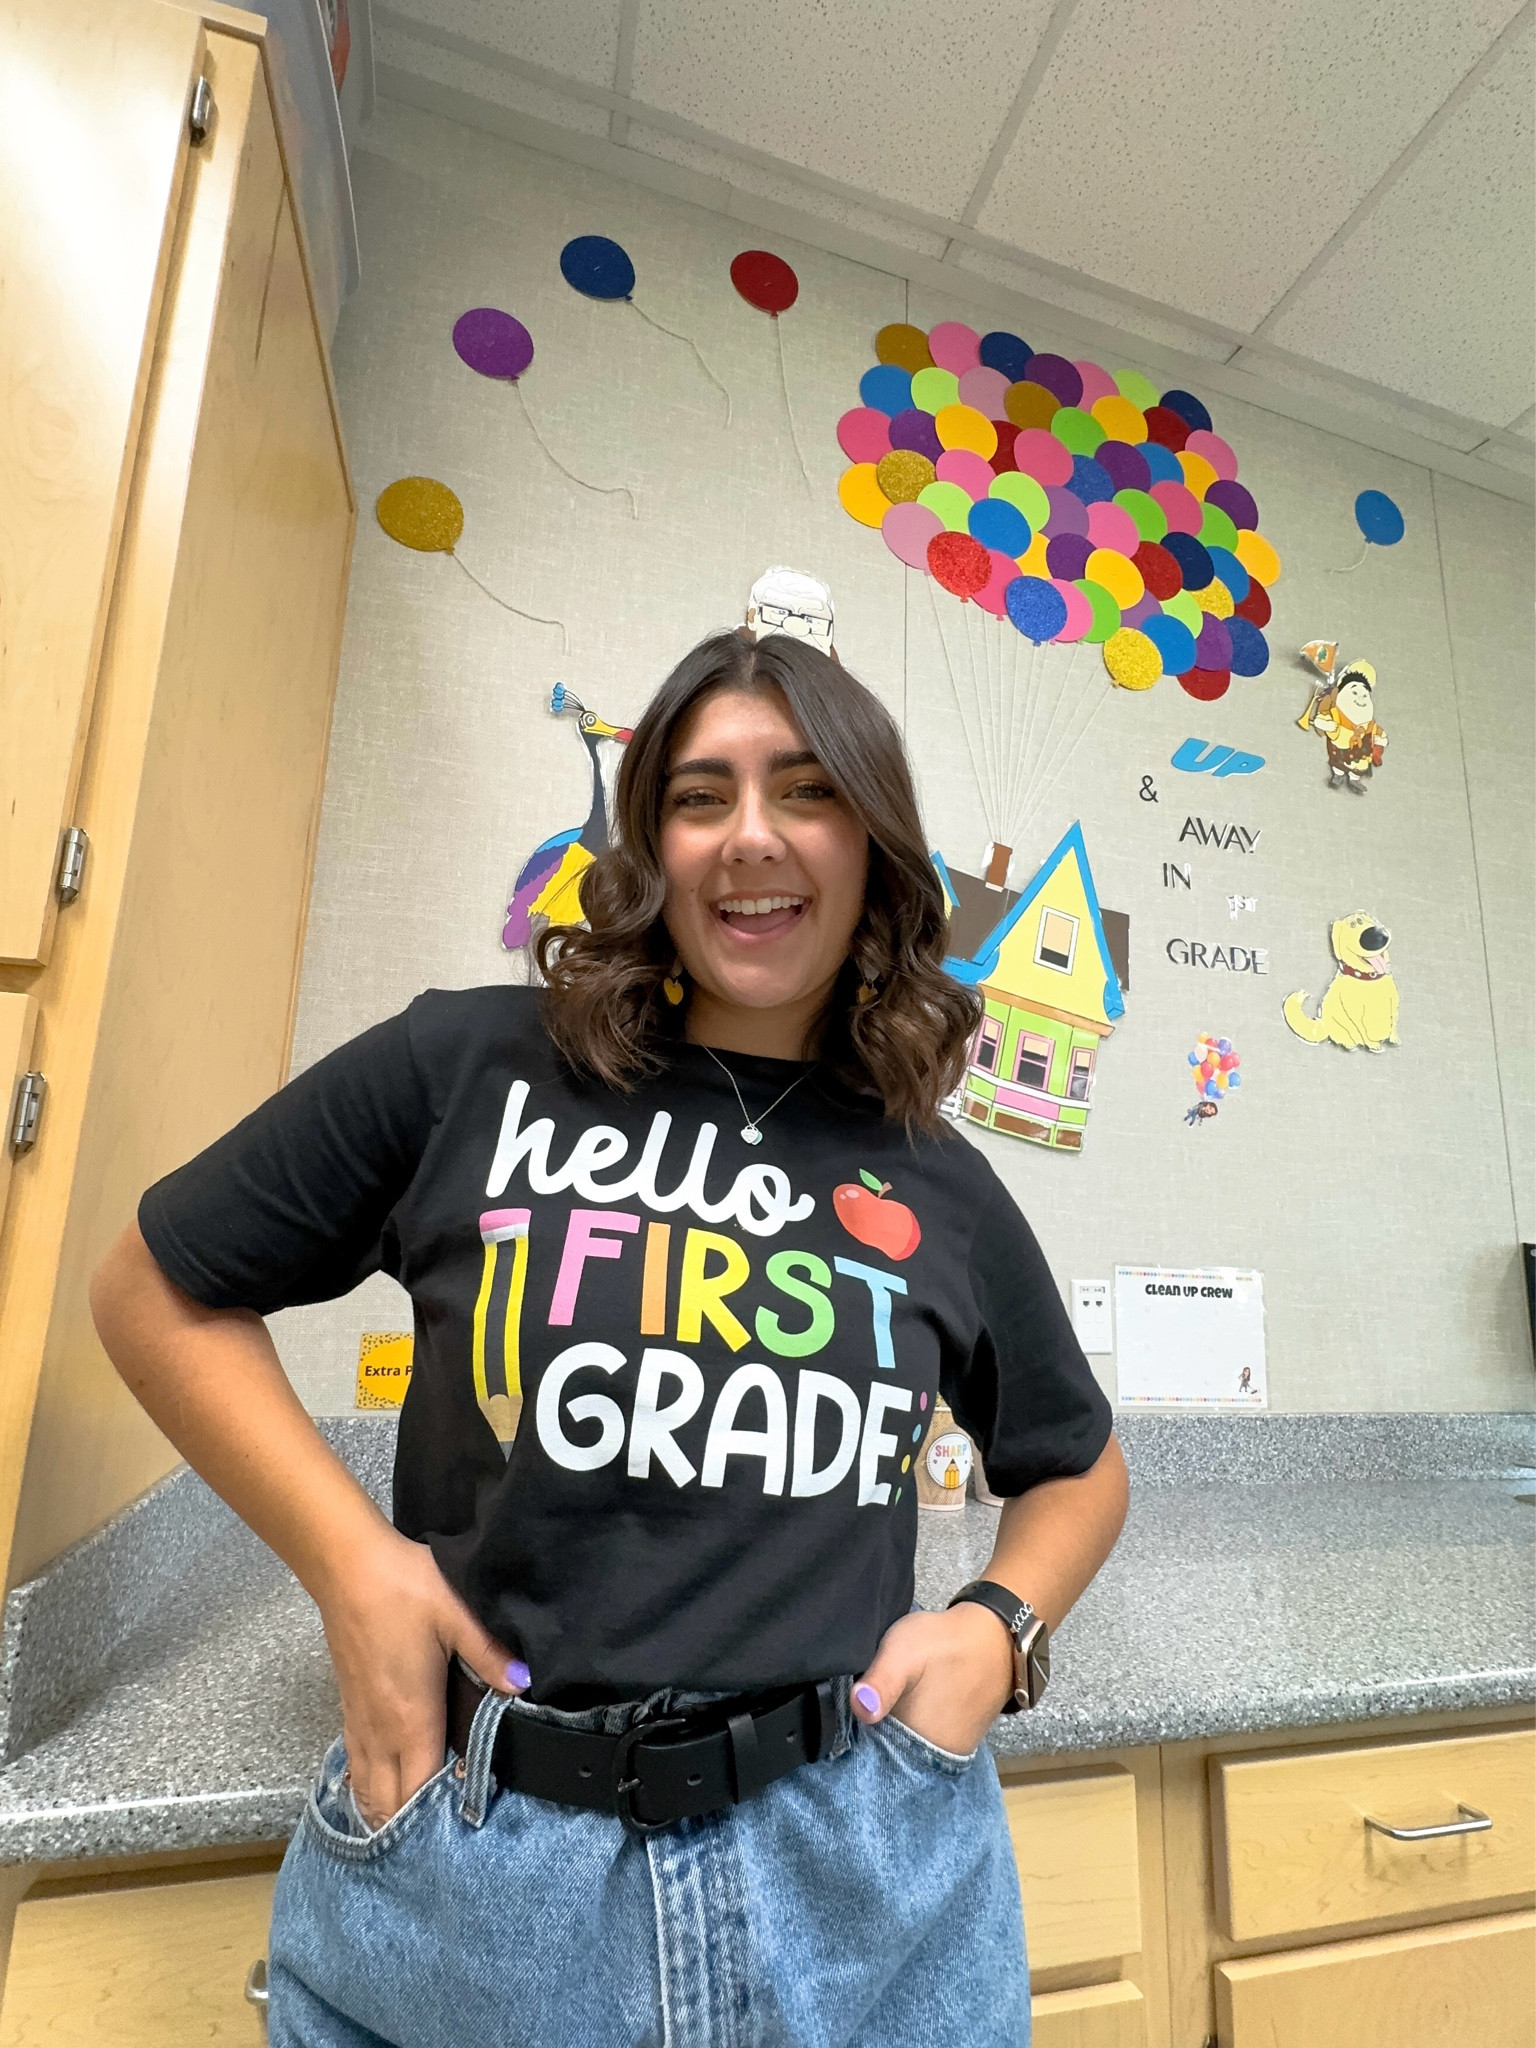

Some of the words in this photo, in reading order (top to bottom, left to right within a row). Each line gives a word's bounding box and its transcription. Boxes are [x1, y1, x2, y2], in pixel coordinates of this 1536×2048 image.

[1171, 737, 1266, 778] UP
[1139, 775, 1158, 803] &
[1178, 816, 1261, 854] AWAY
[1162, 862, 1192, 890] IN
[1166, 938, 1269, 975] GRADE
[485, 1079, 816, 1237] hello
[548, 1208, 908, 1369] FIRST
[1183, 1286, 1198, 1298] UP
[365, 1365, 400, 1377] Extra
[536, 1341, 913, 1507] GRADE
[935, 1443, 968, 1458] SHARP
